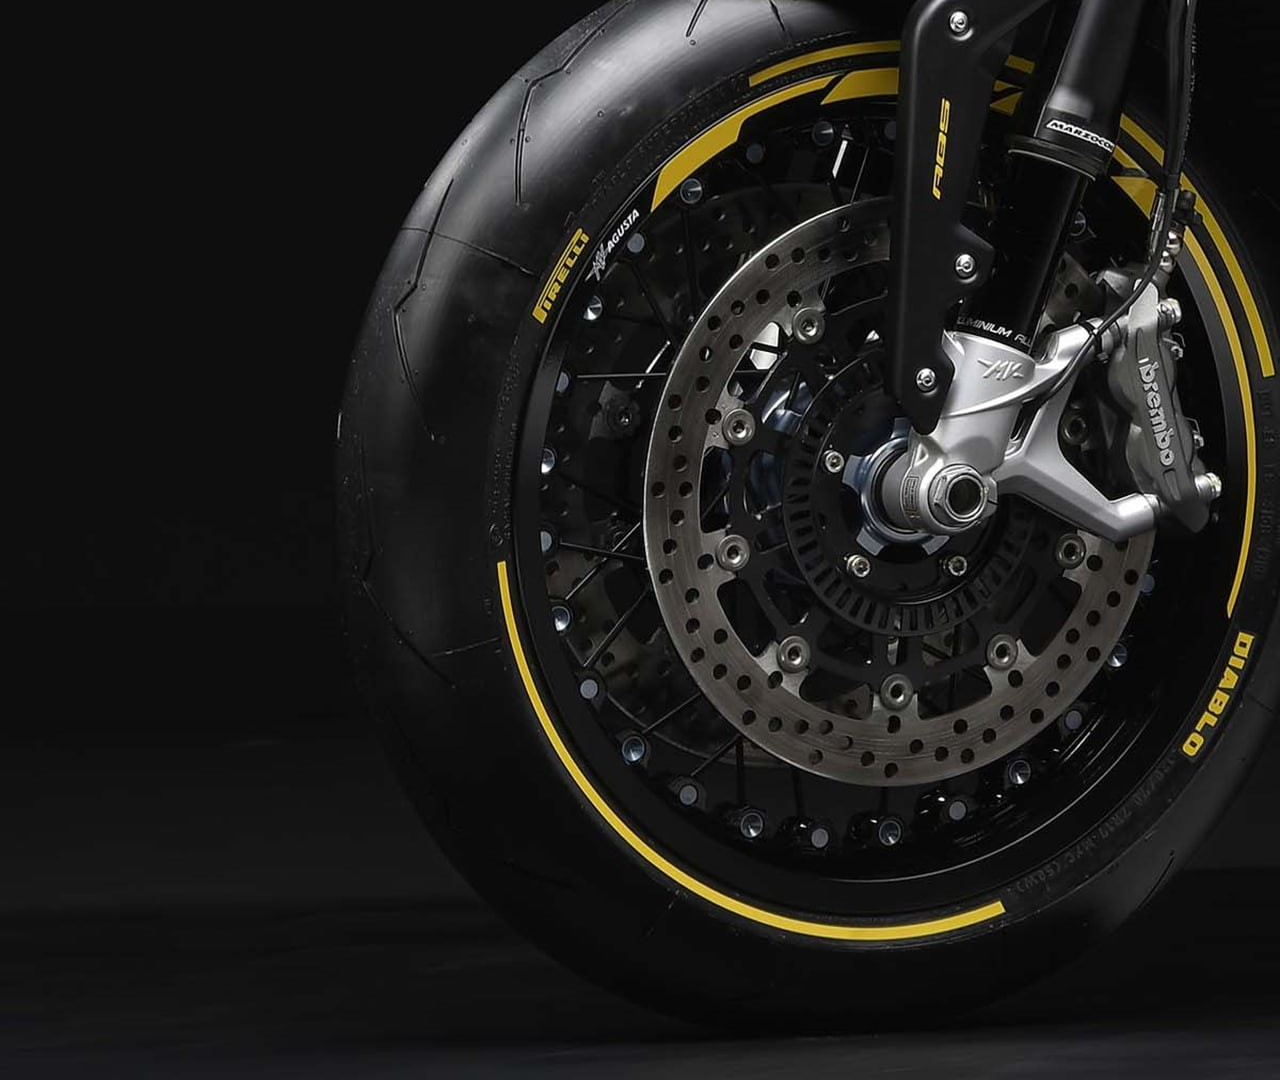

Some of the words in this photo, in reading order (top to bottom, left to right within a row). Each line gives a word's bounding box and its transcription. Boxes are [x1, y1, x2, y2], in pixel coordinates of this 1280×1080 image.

[931, 97, 952, 201] ABS
[531, 227, 592, 325] PIRELLI
[606, 207, 641, 254] AGUSTA
[1138, 362, 1175, 467] brembo
[1180, 630, 1256, 758] DIABLO
